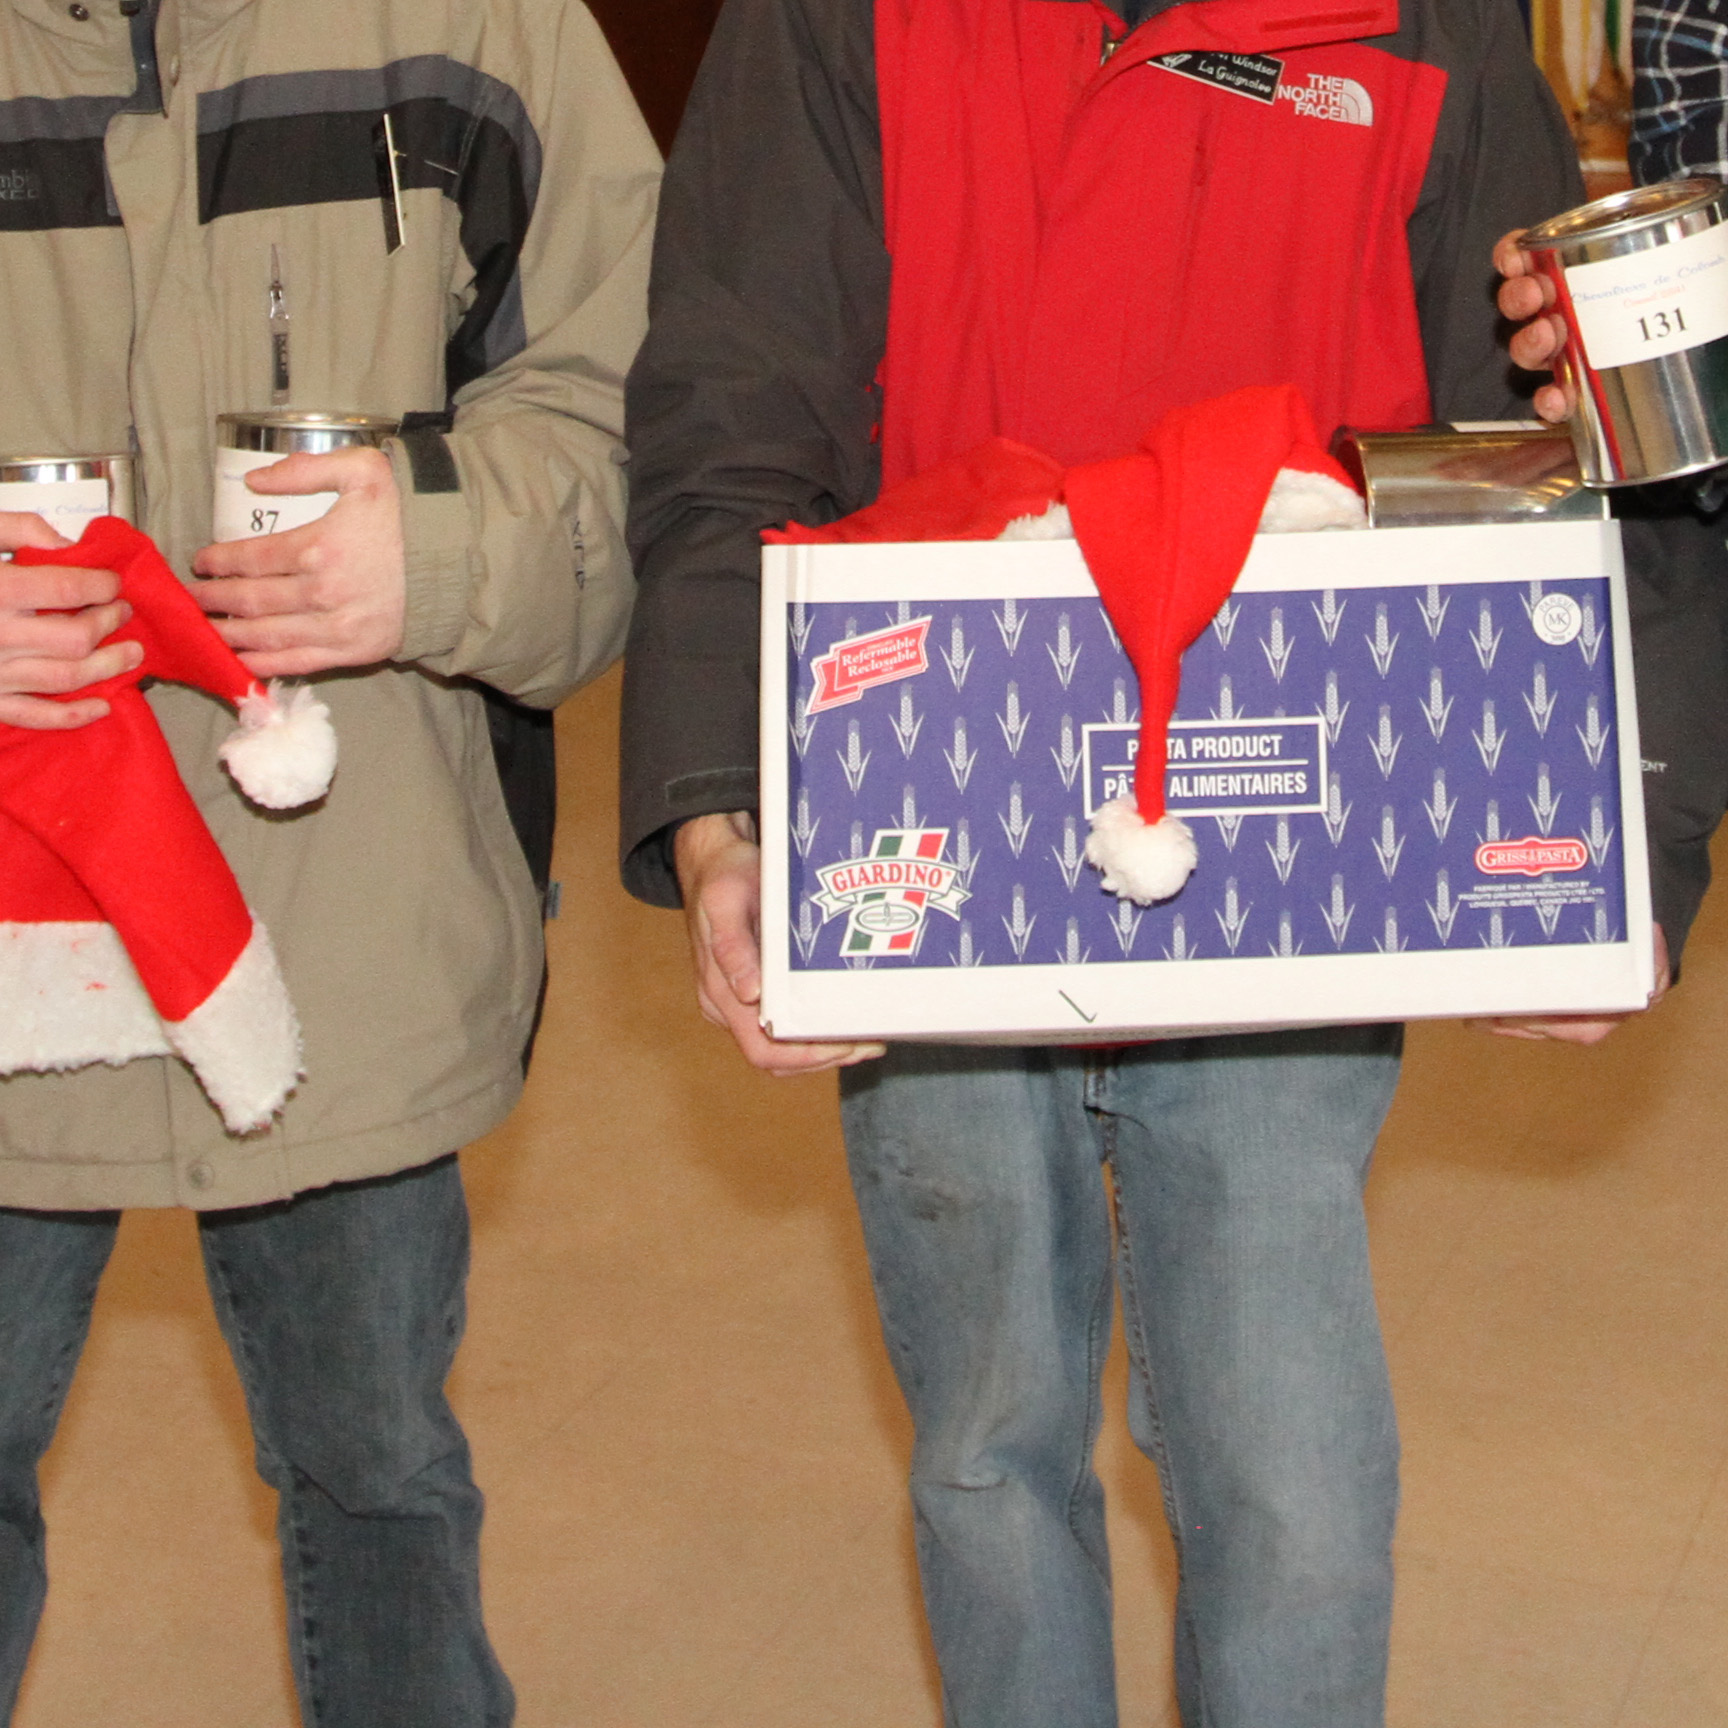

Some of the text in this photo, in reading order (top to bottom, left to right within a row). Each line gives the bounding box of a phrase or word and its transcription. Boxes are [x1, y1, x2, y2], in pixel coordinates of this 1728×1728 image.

[1197, 59, 1214, 75] La
[1231, 53, 1279, 77] Windsor
[1277, 84, 1343, 106] NORTH
[1306, 72, 1345, 91] THE
[1294, 102, 1343, 121] FACE
[1637, 306, 1688, 342] 131
[250, 508, 280, 535] 87
[841, 636, 917, 667] Refermable
[847, 648, 918, 678] Reclosable
[1126, 734, 1283, 761] PTA PRODUCT
[1168, 771, 1309, 798] ALIMENTAIRES
[831, 862, 944, 893] GIARDINO
